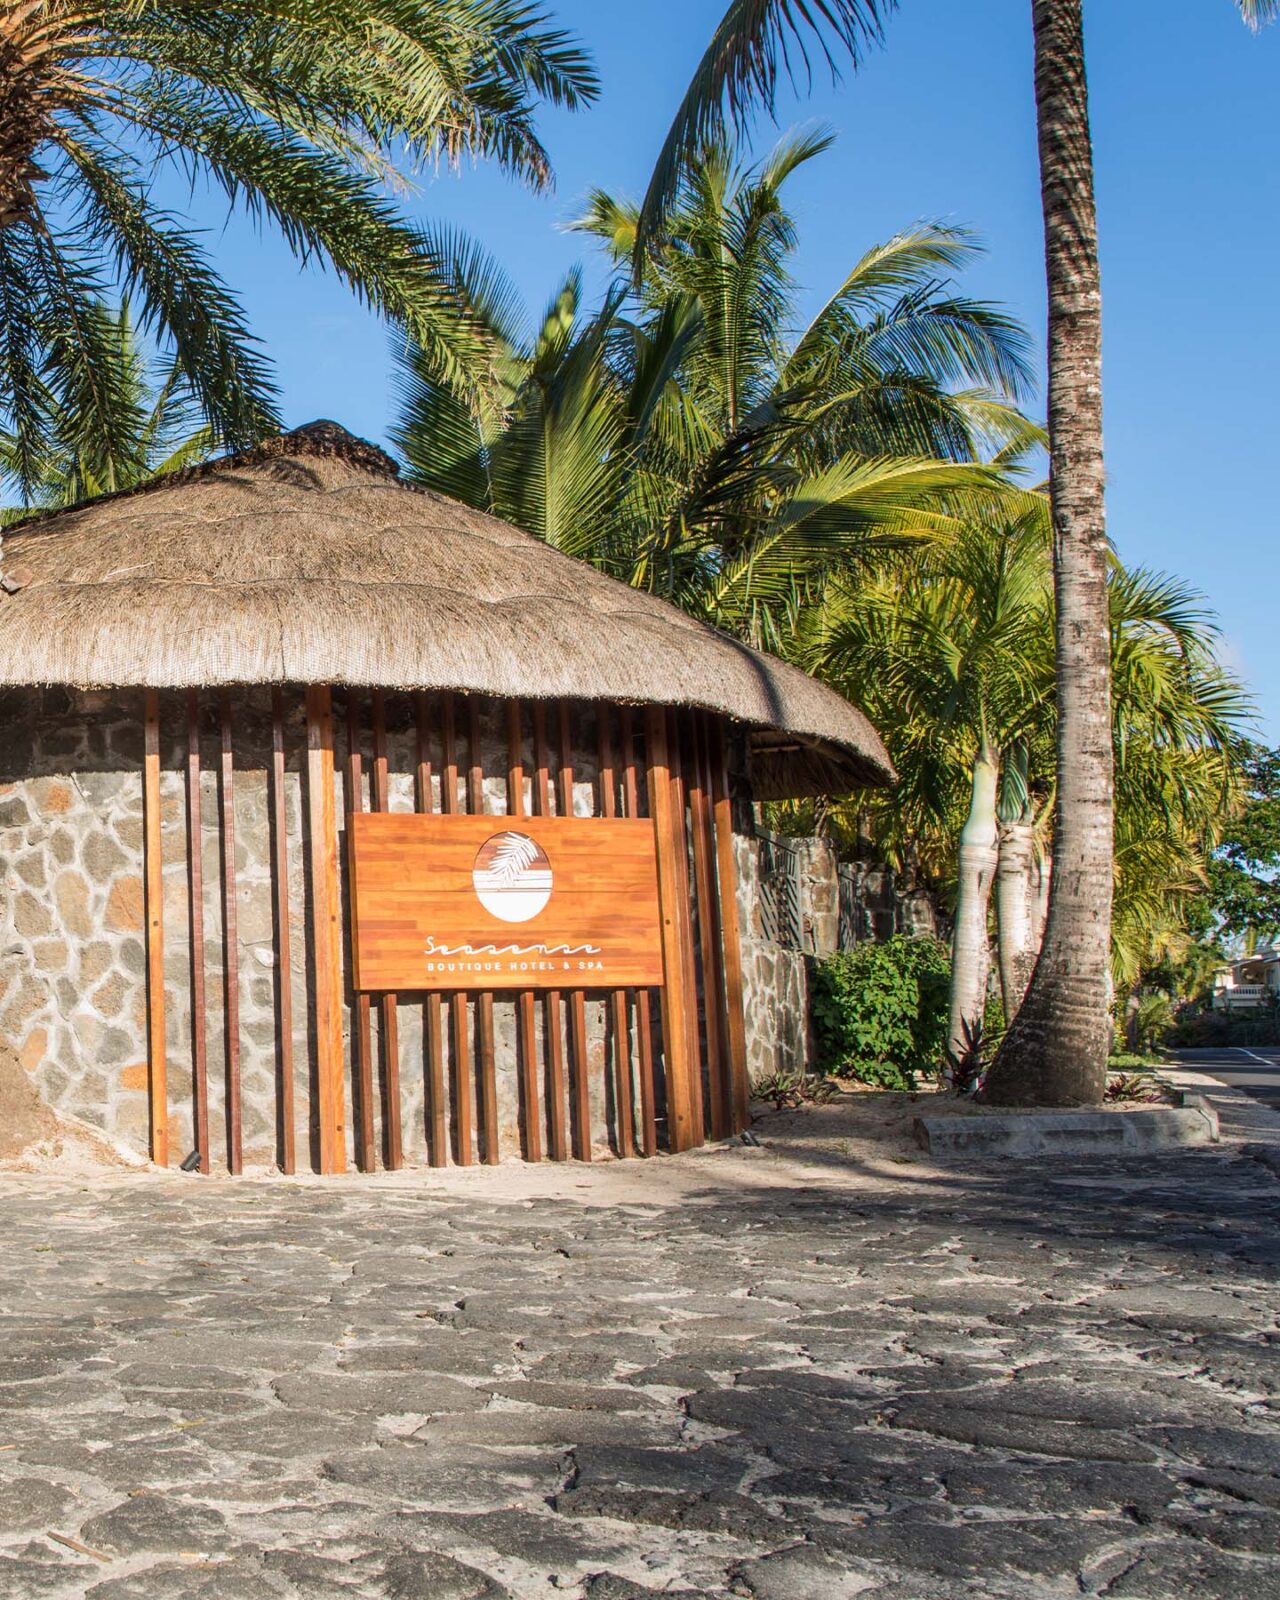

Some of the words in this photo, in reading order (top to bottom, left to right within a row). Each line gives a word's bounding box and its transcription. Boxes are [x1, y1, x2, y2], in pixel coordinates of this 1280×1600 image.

[427, 962, 502, 972] BOUTIQUE
[510, 961, 555, 971] HOTEL
[562, 961, 570, 971] &
[578, 961, 604, 971] SPA
